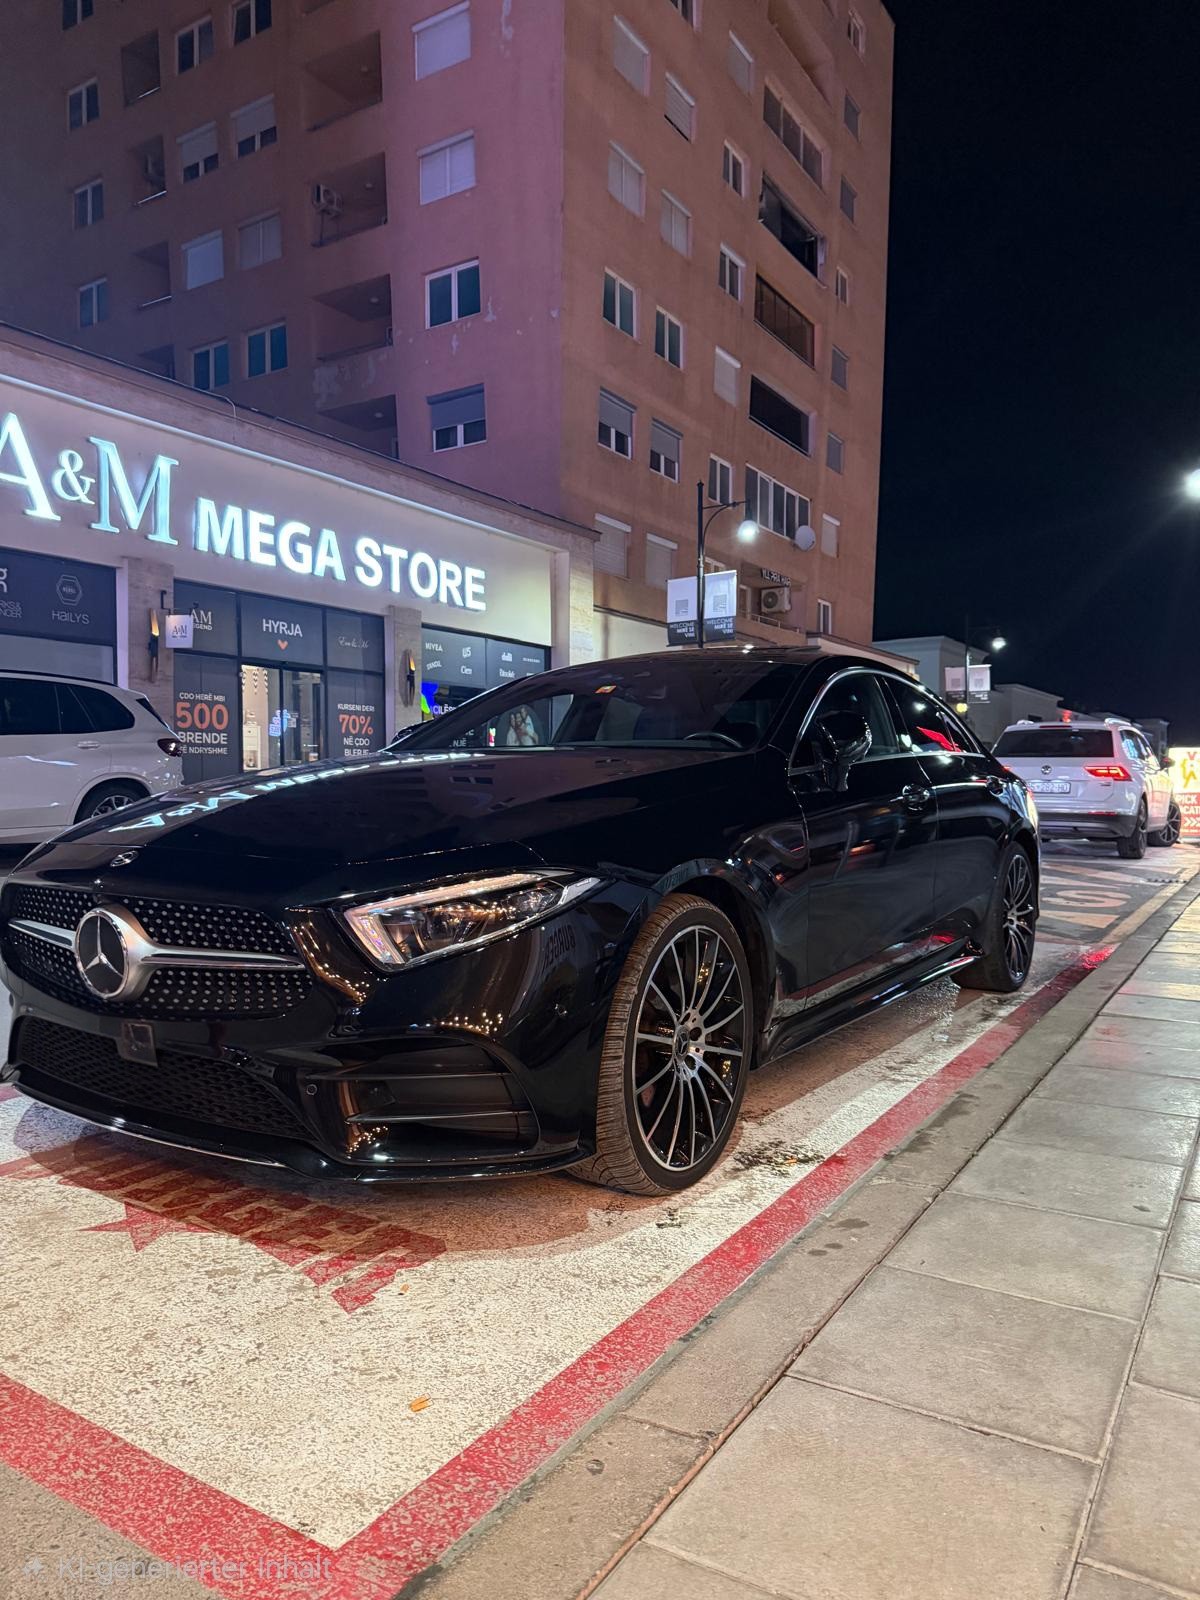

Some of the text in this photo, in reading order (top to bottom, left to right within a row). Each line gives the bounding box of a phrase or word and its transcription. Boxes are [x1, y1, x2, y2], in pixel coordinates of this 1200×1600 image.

[0, 411, 487, 612] A&M MEGA STORE
[262, 618, 303, 638] HYRJA
[176, 701, 229, 731] 500
[339, 714, 374, 735] 70%
[178, 731, 228, 745] BRENDE
